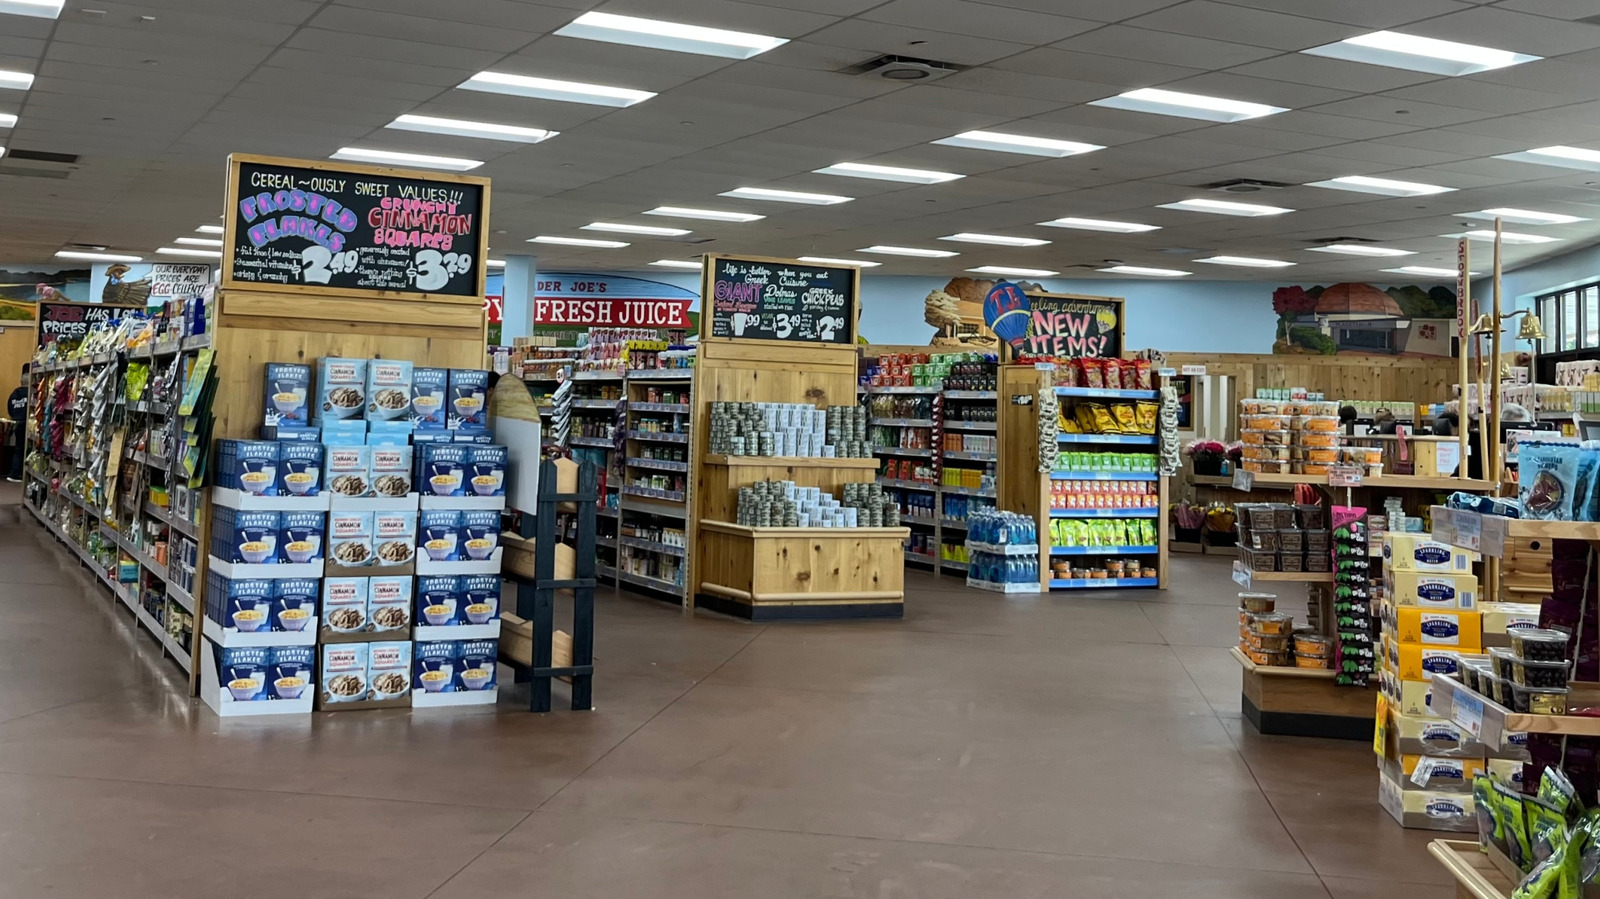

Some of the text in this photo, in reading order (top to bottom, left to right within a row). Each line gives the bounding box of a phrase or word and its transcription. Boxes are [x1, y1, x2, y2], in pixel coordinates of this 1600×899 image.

[355, 182, 389, 197] SWEET
[399, 186, 463, 204] VALUES!!!
[240, 190, 358, 232] FROSTED
[381, 197, 457, 214] CRUNCHY
[368, 208, 472, 235] CINNAMON
[248, 216, 346, 253] FLAKES
[374, 228, 453, 250] SQUARES
[172, 266, 208, 274] EVERYDAY
[184, 275, 200, 283] ARE
[745, 274, 769, 285] Greek
[570, 282, 607, 292] JOE'S
[715, 280, 763, 302] GIANT
[45, 305, 84, 322] JOE
[85, 308, 109, 321] HAS
[536, 299, 612, 322] FRESH
[619, 302, 682, 324] JUICE
[42, 321, 87, 334] PRICES
[1032, 311, 1090, 338] NEW
[1030, 334, 1107, 358] ITEMS!
